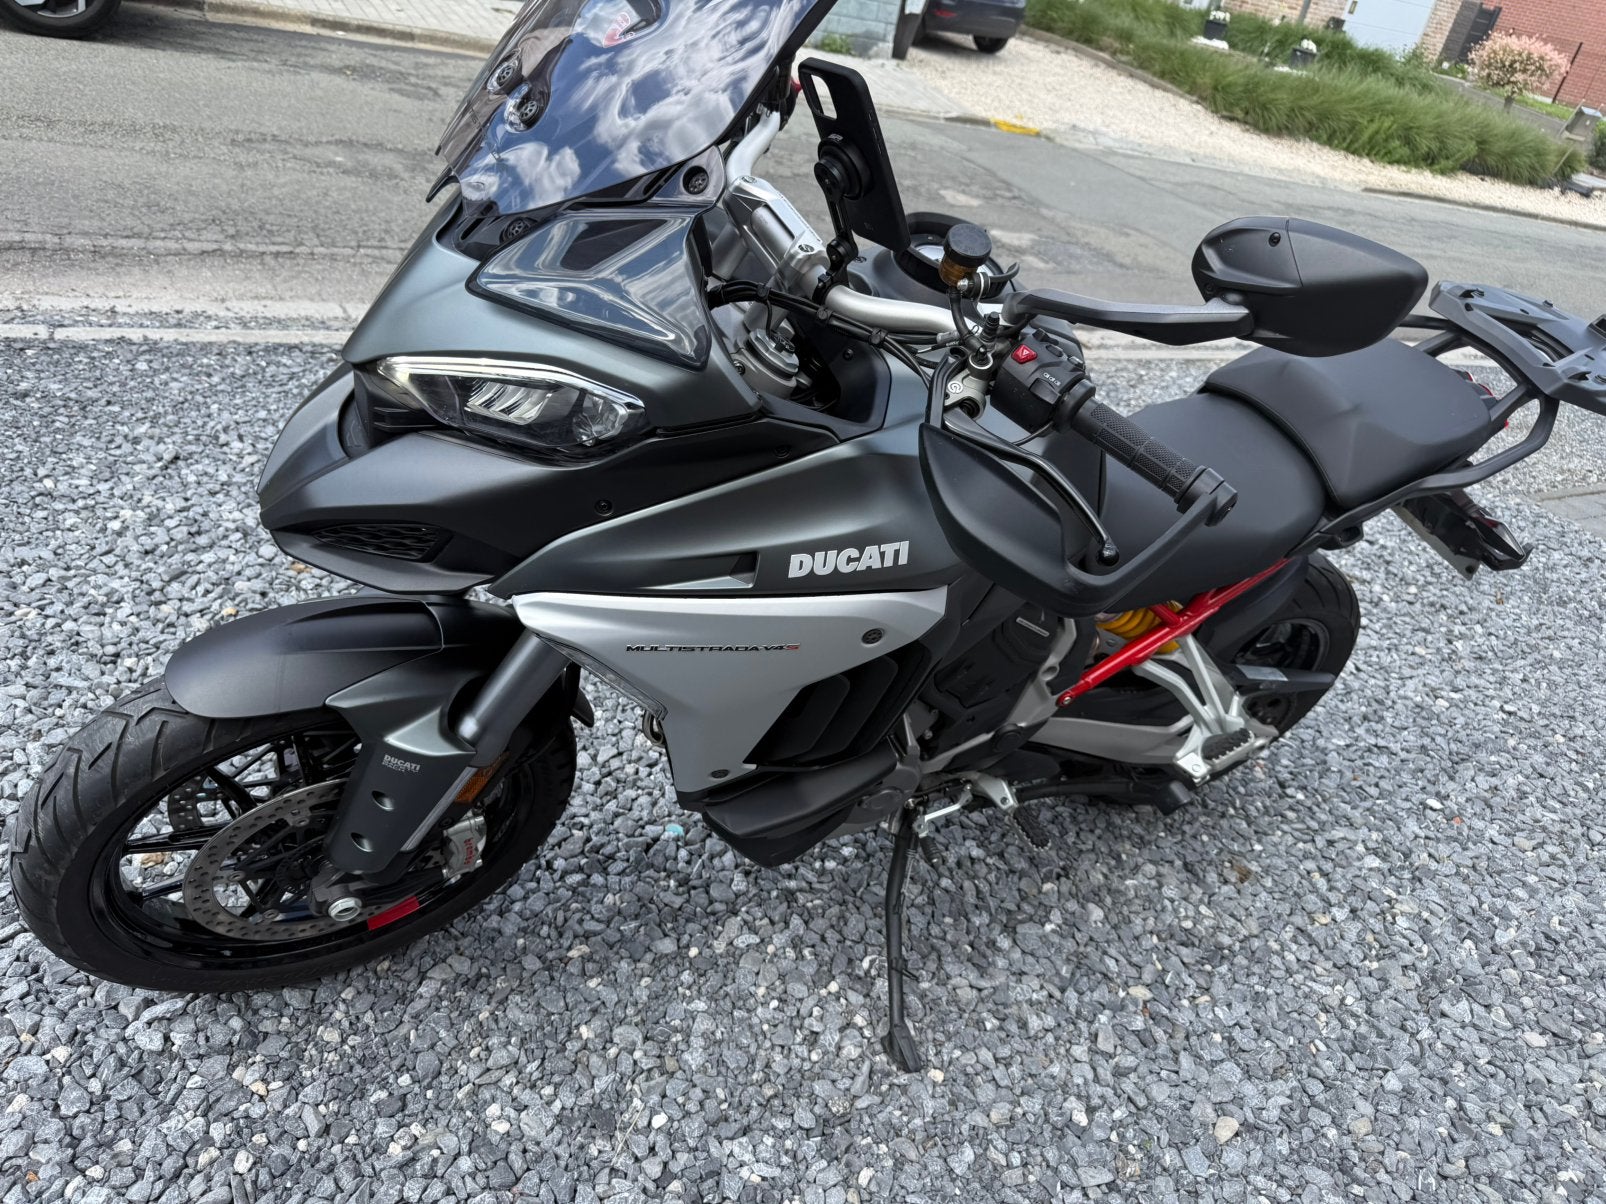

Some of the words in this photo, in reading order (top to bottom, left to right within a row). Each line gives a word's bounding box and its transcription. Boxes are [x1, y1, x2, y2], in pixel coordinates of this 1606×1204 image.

[788, 540, 910, 578] DUCATI
[626, 644, 759, 653] MULTISTRADA
[383, 754, 421, 771] DUCATI
